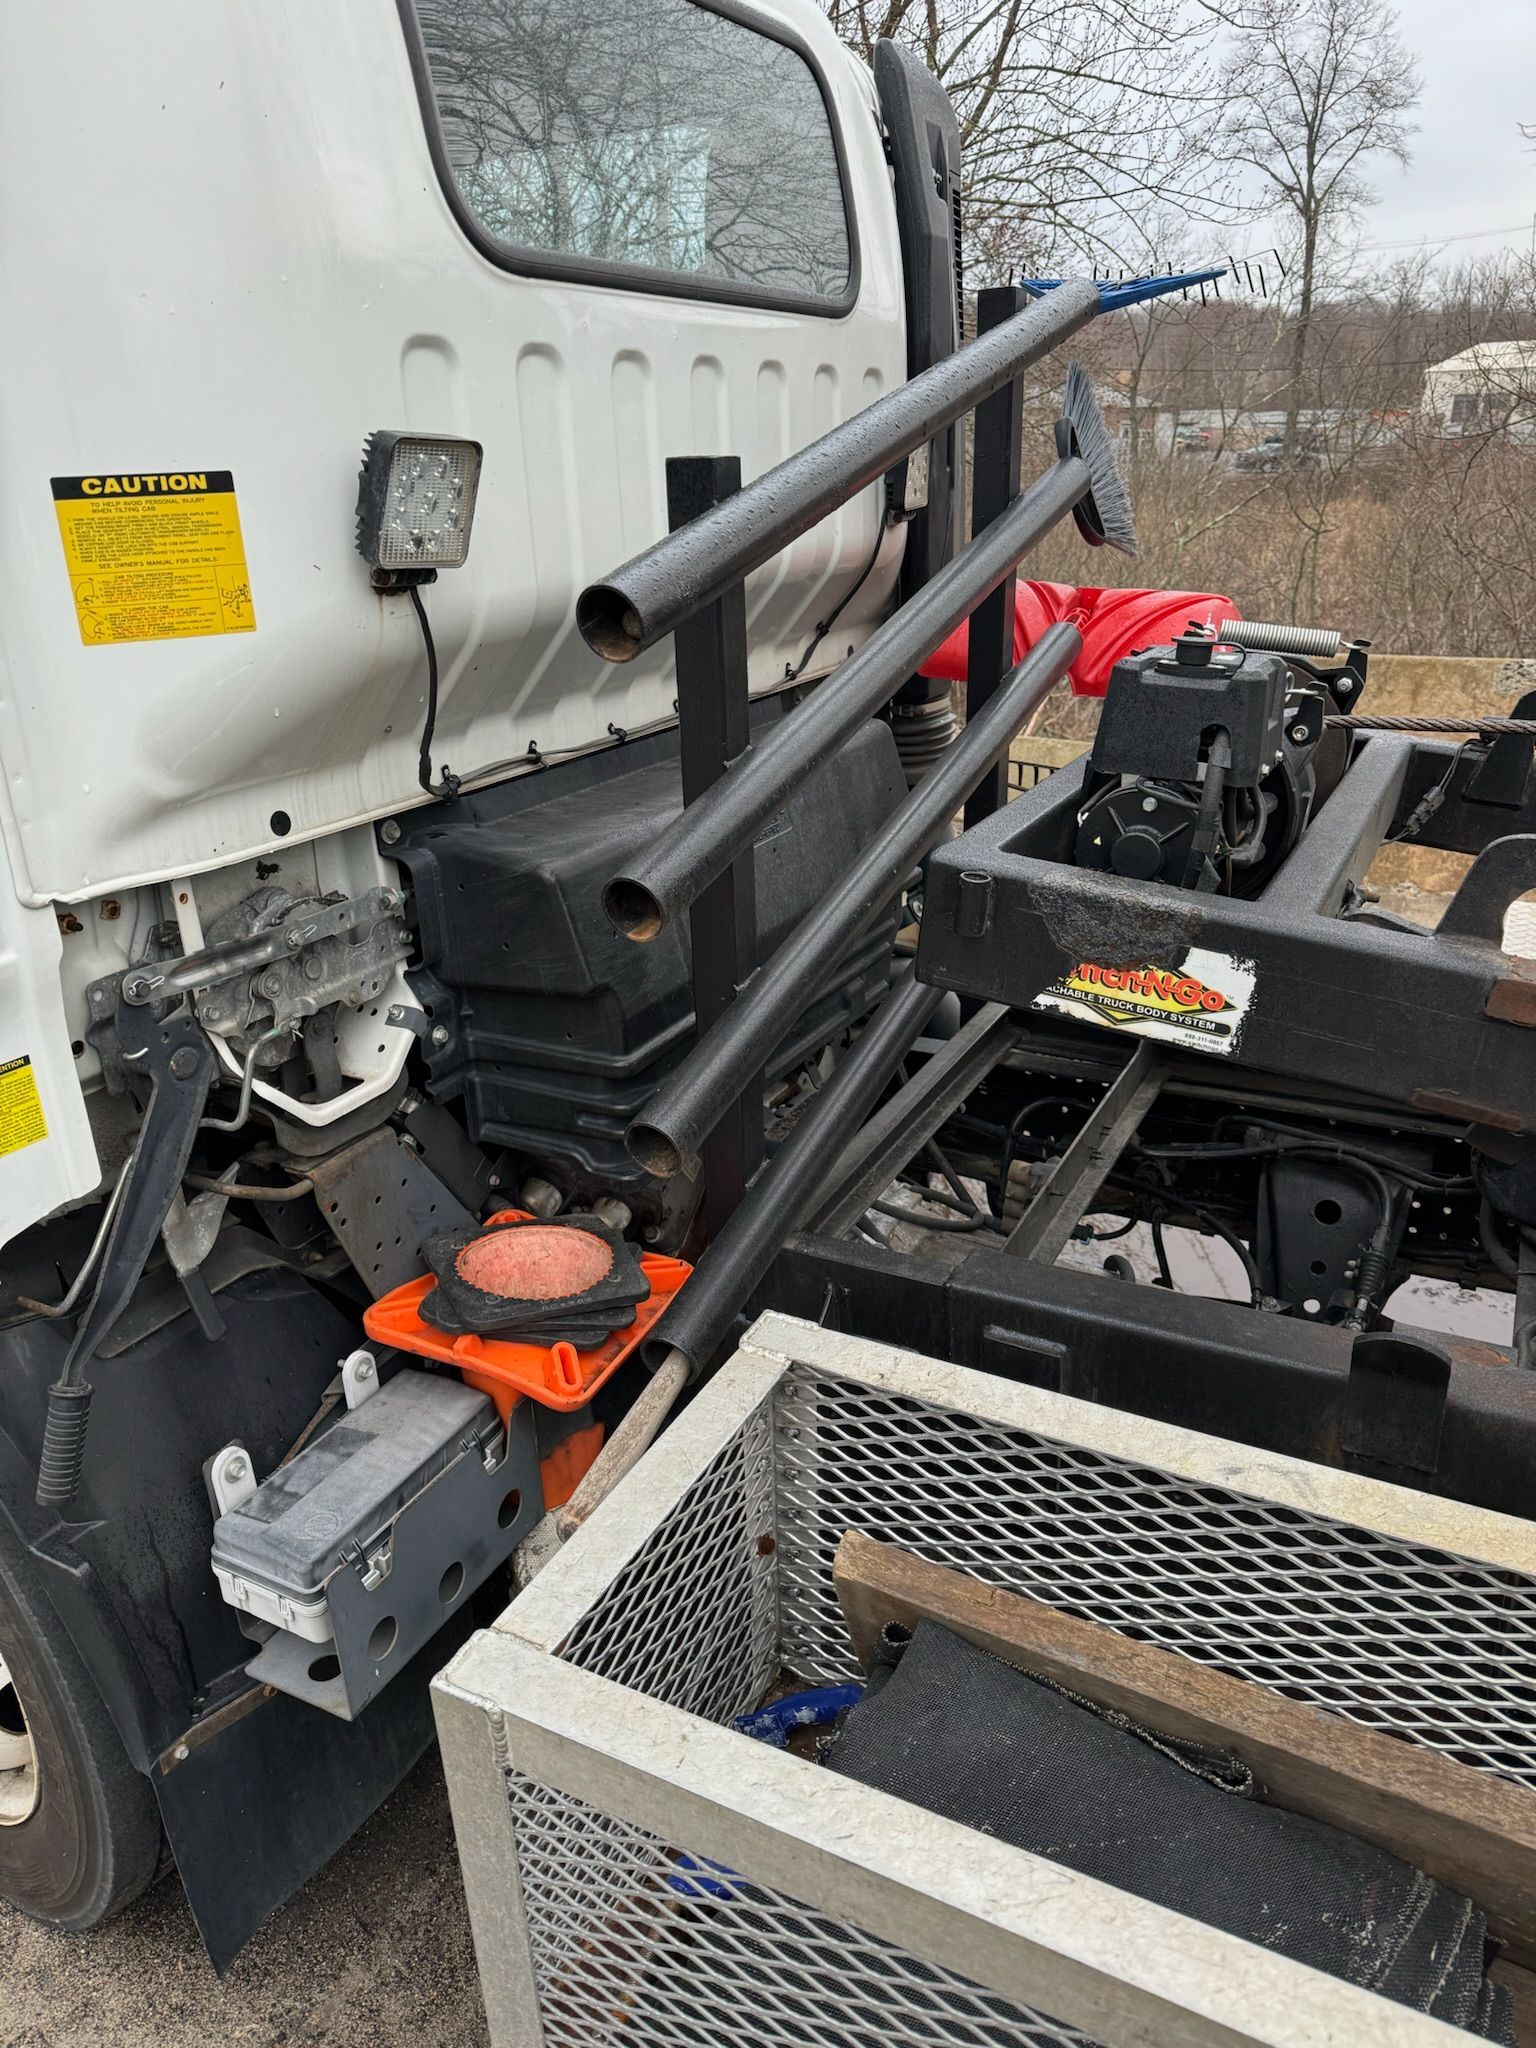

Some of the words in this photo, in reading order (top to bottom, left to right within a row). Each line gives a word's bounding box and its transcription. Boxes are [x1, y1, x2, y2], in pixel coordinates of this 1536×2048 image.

[81, 474, 207, 495] CAUTION
[1098, 996, 1134, 1012] TRUCK
[1136, 1005, 1169, 1019] BODY
[1170, 1014, 1216, 1031] SYSTEM
